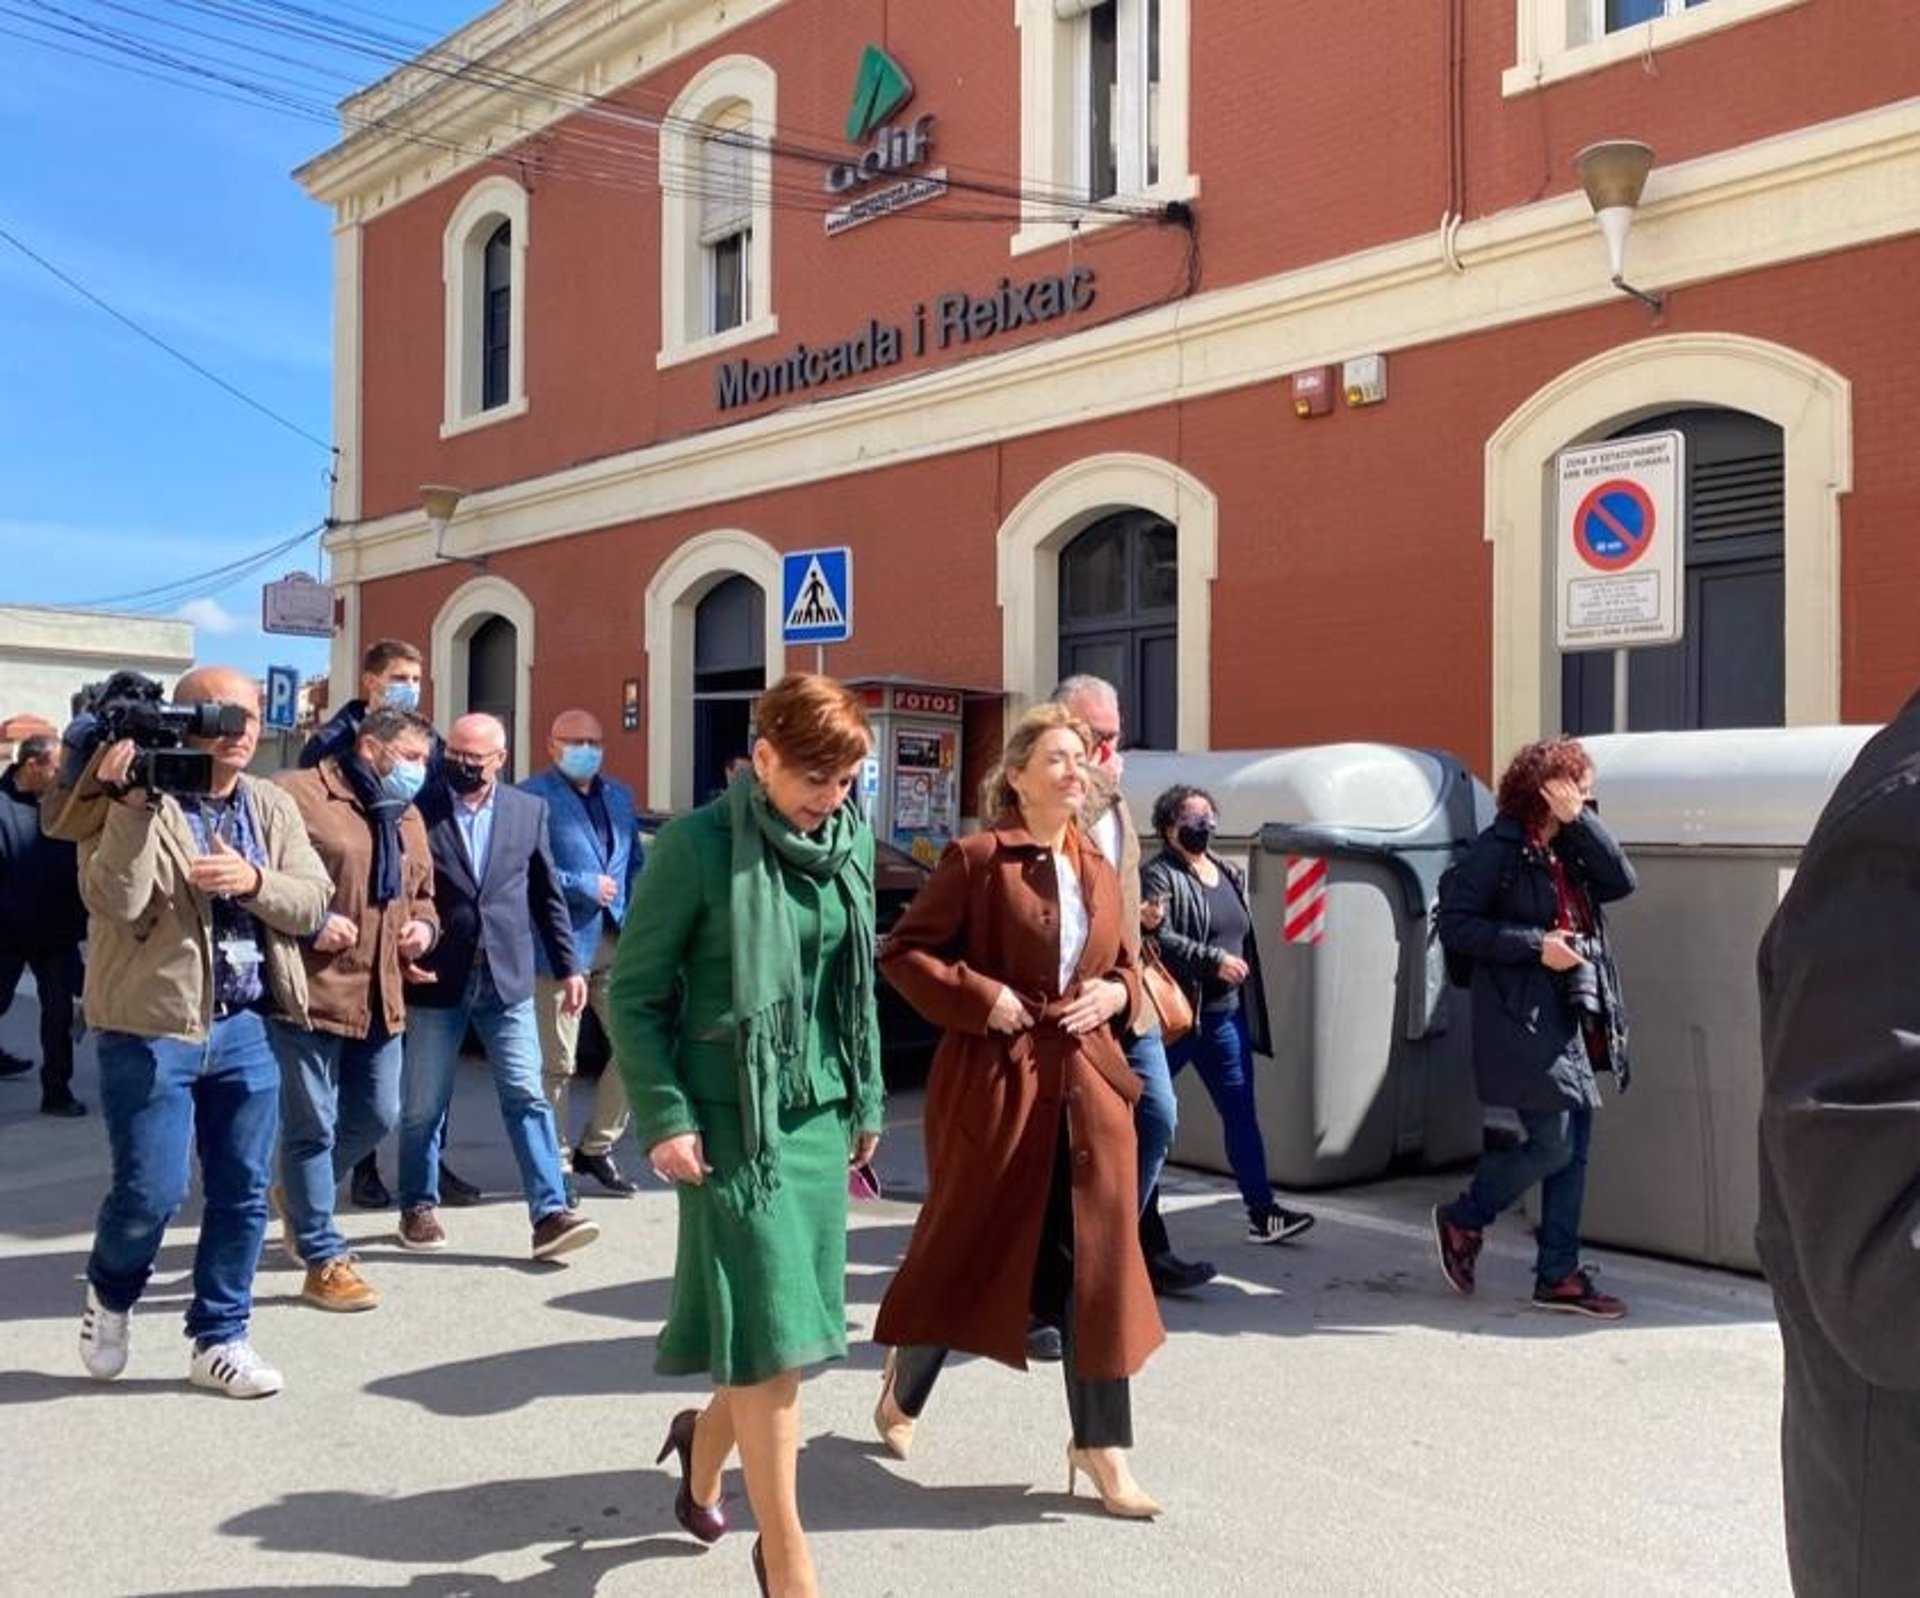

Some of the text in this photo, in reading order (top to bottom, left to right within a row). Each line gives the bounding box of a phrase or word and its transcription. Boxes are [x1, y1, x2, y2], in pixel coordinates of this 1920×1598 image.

[824, 114, 936, 193] adif
[714, 266, 1096, 410] Montcada i Reixac
[271, 673, 292, 723] P
[896, 692, 957, 712] FOTOS
